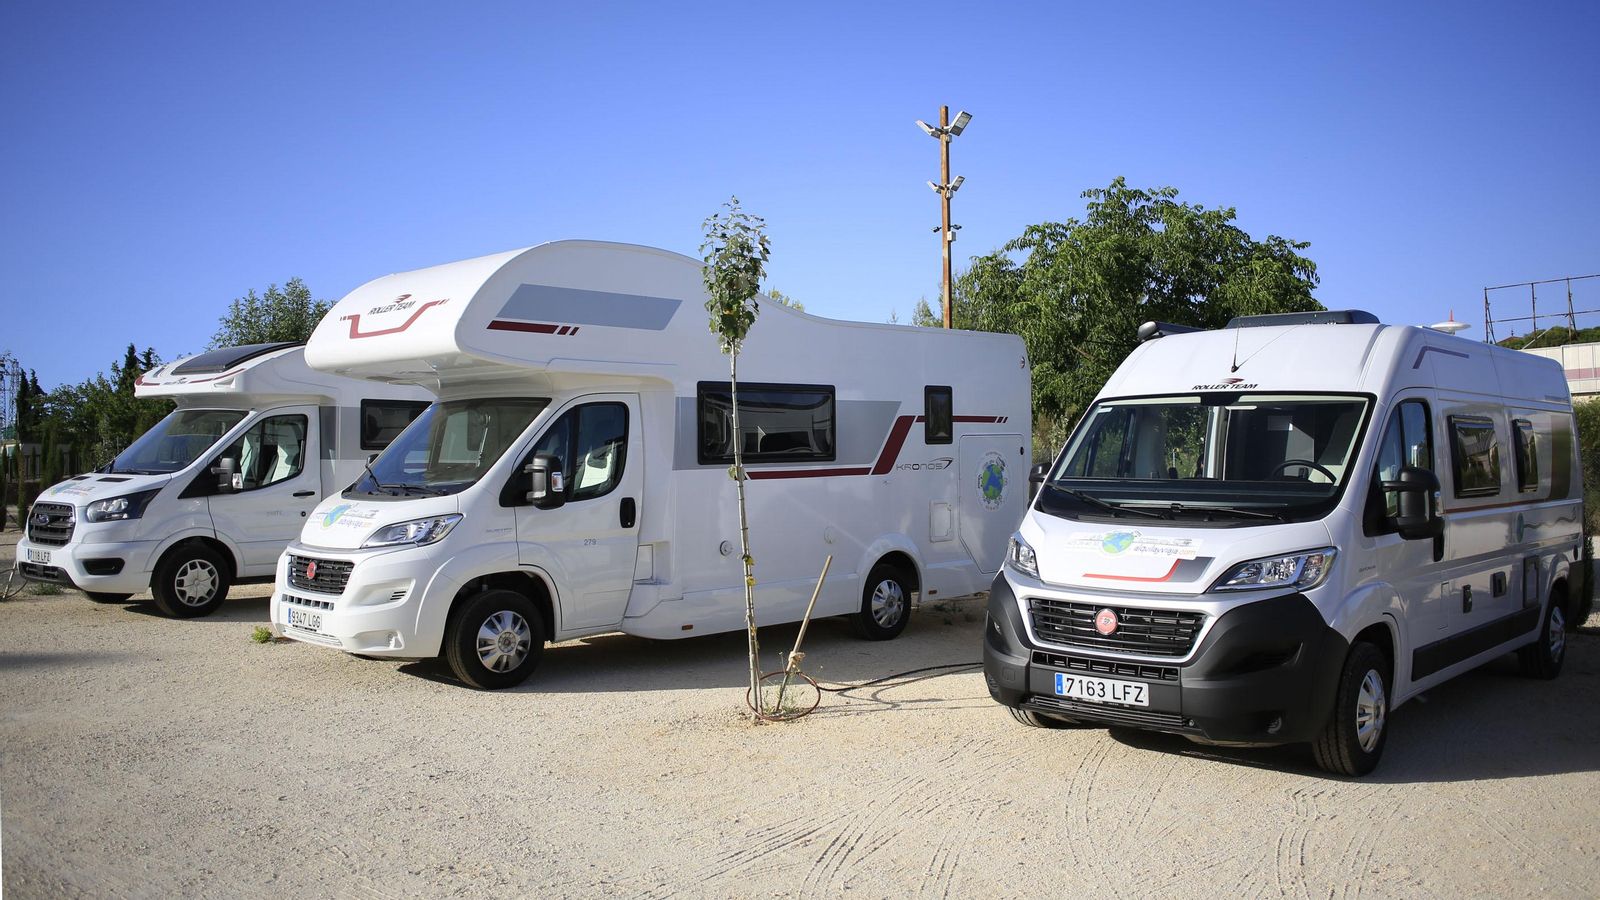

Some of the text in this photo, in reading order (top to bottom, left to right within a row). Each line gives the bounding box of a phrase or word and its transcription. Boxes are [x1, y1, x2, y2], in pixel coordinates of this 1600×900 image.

[583, 538, 598, 546] 279
[291, 610, 307, 625] 9347
[1066, 677, 1144, 703] 7163 LFZ
